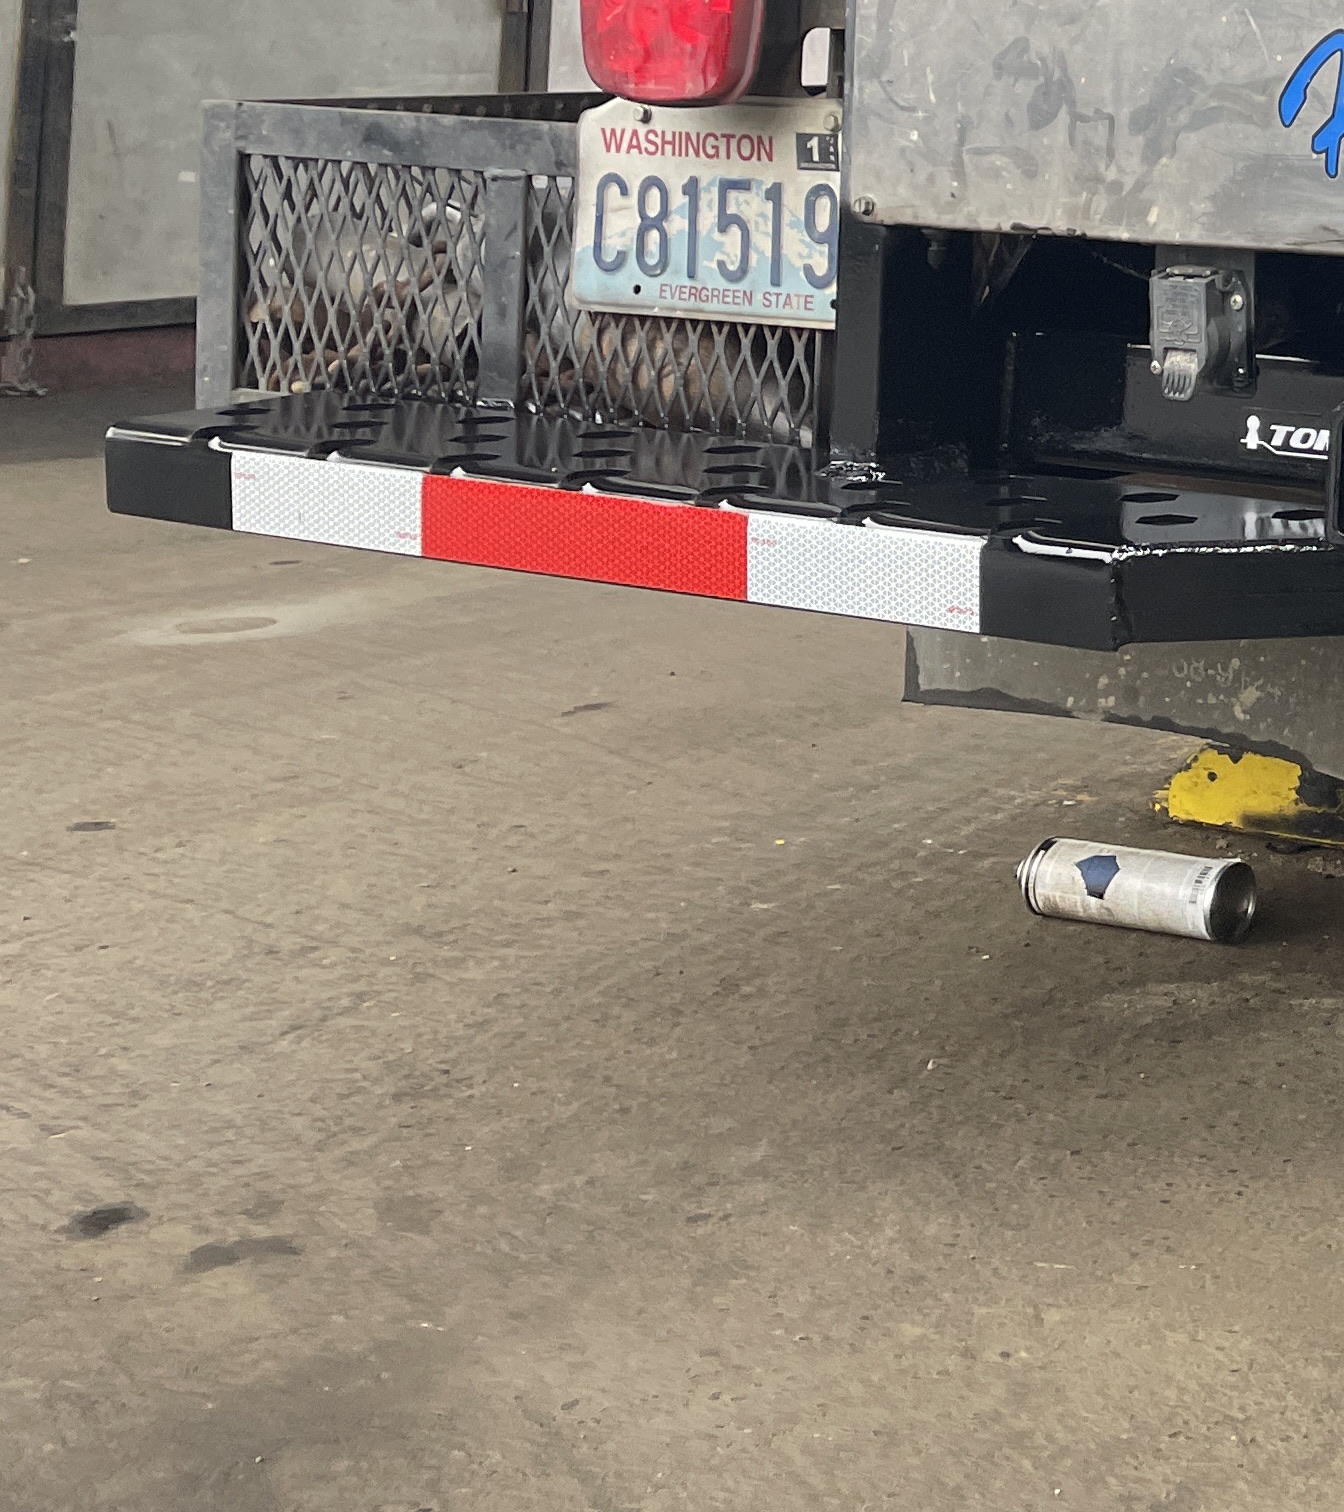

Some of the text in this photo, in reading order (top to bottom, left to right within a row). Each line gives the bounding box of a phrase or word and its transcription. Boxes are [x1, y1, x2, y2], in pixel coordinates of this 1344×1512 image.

[601, 127, 775, 162] WASHINGTON
[592, 171, 838, 289] C81519
[658, 283, 815, 312] EVERGREEN STATE
